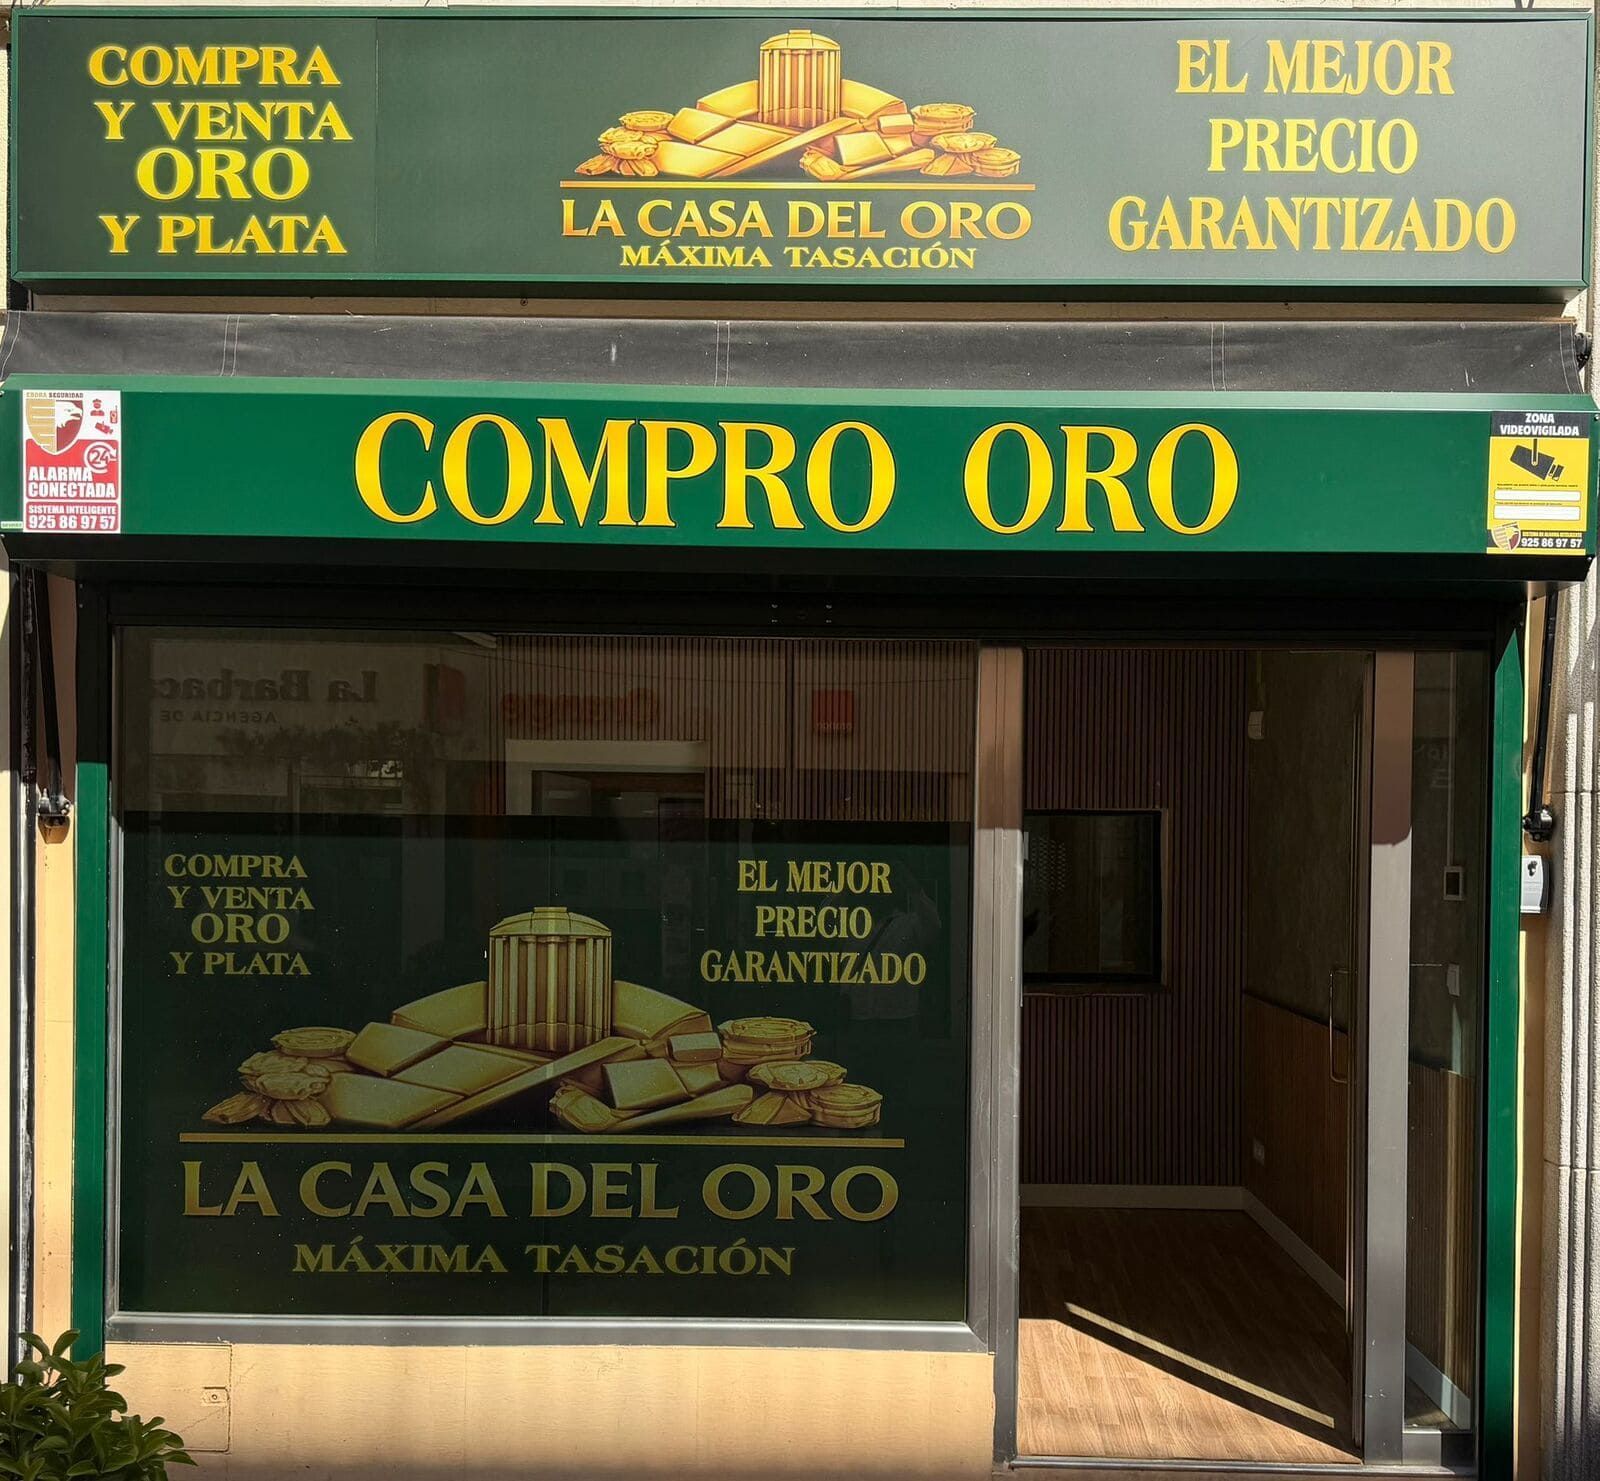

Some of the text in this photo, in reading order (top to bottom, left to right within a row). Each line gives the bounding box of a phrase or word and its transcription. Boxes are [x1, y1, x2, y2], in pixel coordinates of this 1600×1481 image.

[88, 45, 341, 87] COMPRA
[1176, 39, 1455, 96] EL MEJOR
[96, 101, 352, 142] Y VENTA
[1208, 118, 1420, 175] PRECIO
[136, 148, 311, 202] ORO
[101, 215, 347, 255] Y PLATA
[562, 199, 1033, 241] LA CASA DEL ORO
[1108, 195, 1517, 255] GARANTIZADO
[621, 239, 976, 270] MÁXIMA TASACIÓN
[1500, 424, 1580, 437] VIDEOVIGILADA
[1525, 413, 1555, 424] ZONA
[28, 466, 93, 482] ALARMA
[89, 449, 109, 465] 24
[355, 412, 1240, 535] COMPRO ORO
[28, 481, 116, 498] CONECTADA
[28, 504, 116, 515] SISTEMA INTELIGENTE
[29, 514, 56, 529] 925
[59, 515, 78, 529] 86
[81, 515, 97, 529] 97
[100, 515, 116, 529] 57
[1521, 537, 1583, 548] 925 86 97 57
[164, 853, 308, 881] COMPRA
[738, 859, 893, 894] EL MEJOR
[169, 885, 314, 912] Y VENTA
[191, 913, 291, 946] ORO
[755, 905, 874, 940] PRECIO
[171, 952, 311, 977] Y PLATA
[700, 950, 928, 986] GARANTIZADO
[182, 1160, 900, 1222] LA CASA DEL ORO
[292, 1235, 795, 1277] MÁXIMA TASACIÓN
